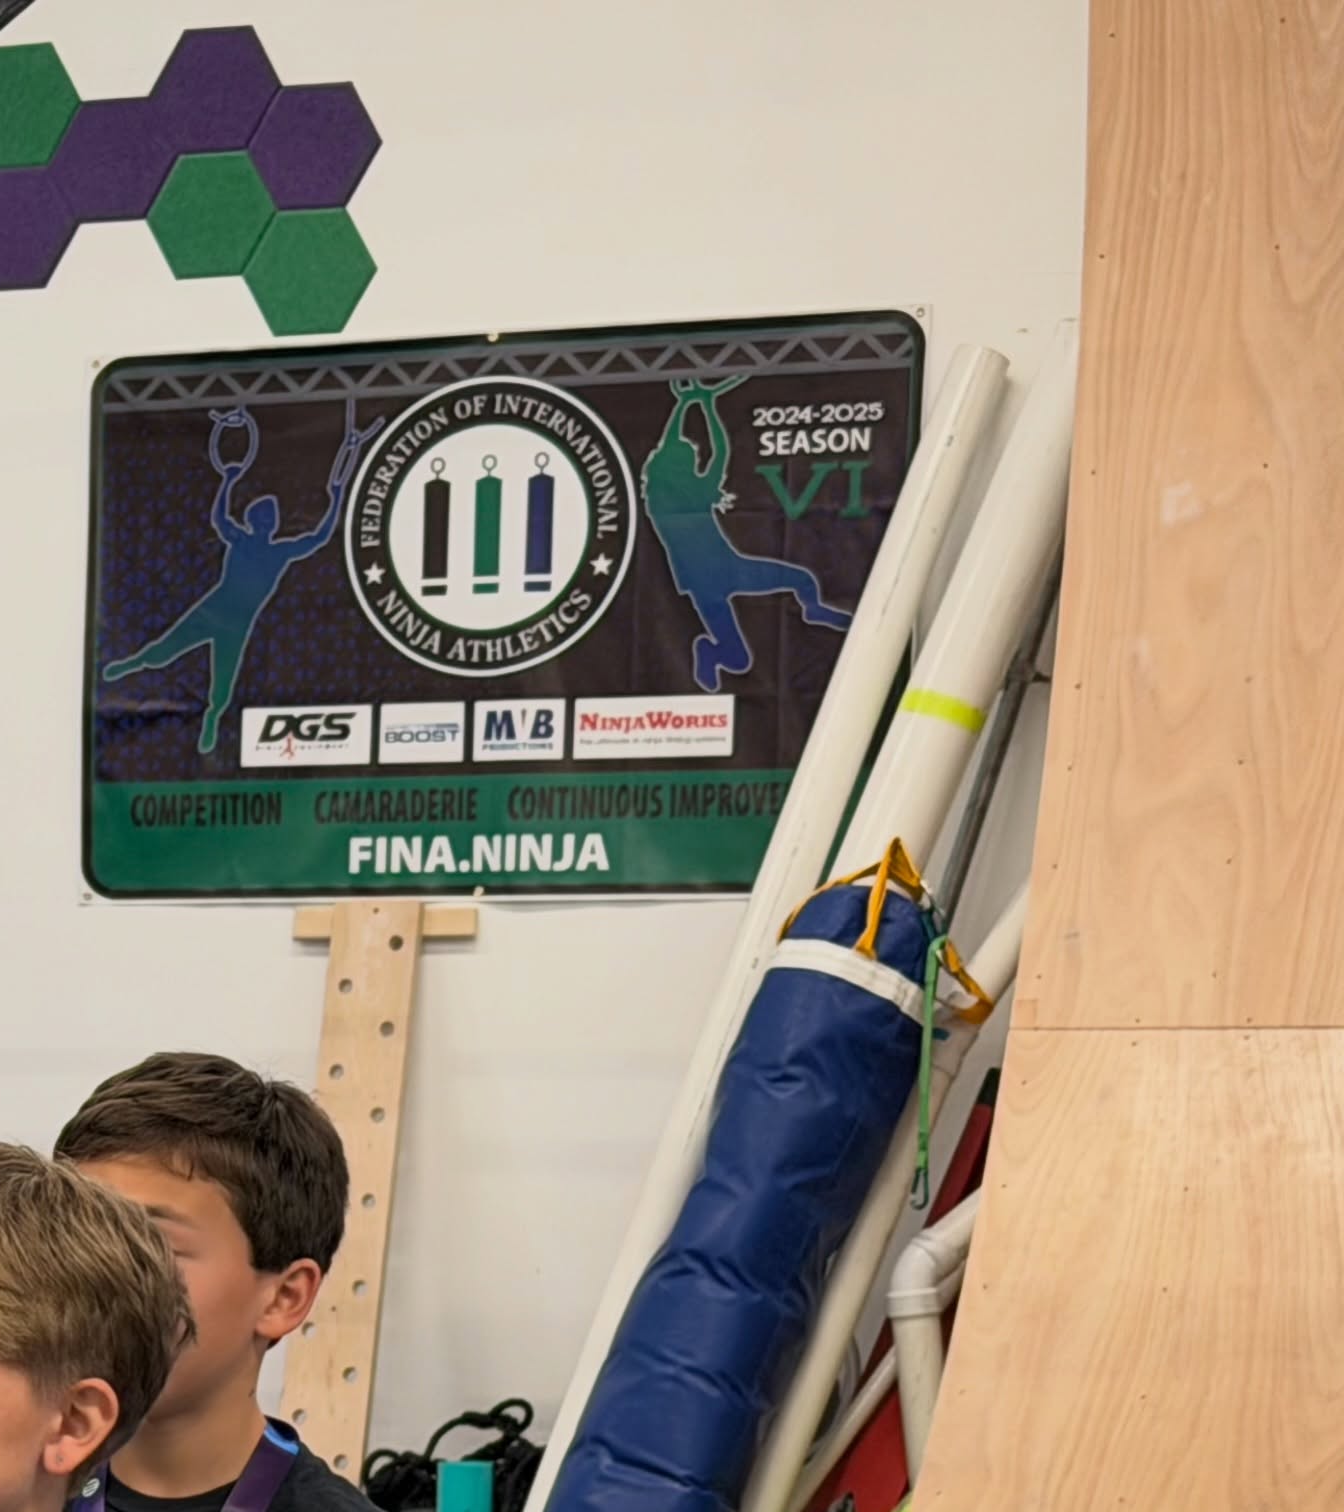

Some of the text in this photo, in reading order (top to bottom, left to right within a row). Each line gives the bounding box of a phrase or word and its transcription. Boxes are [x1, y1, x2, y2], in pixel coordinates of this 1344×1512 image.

[751, 401, 885, 428] 2024-2025
[758, 427, 873, 458] SEASON
[360, 393, 618, 548] FEDERATION OF INTERNATIONAL
[756, 460, 874, 520] VI
[376, 587, 593, 663] NINJA ATHLETICS
[258, 712, 357, 743] DGS
[384, 729, 460, 744] BOOST
[130, 782, 787, 828] COMPETITION CAMARADERIE CONTINUOUS IMPROVE
[348, 832, 609, 874] FINA.NINJA
